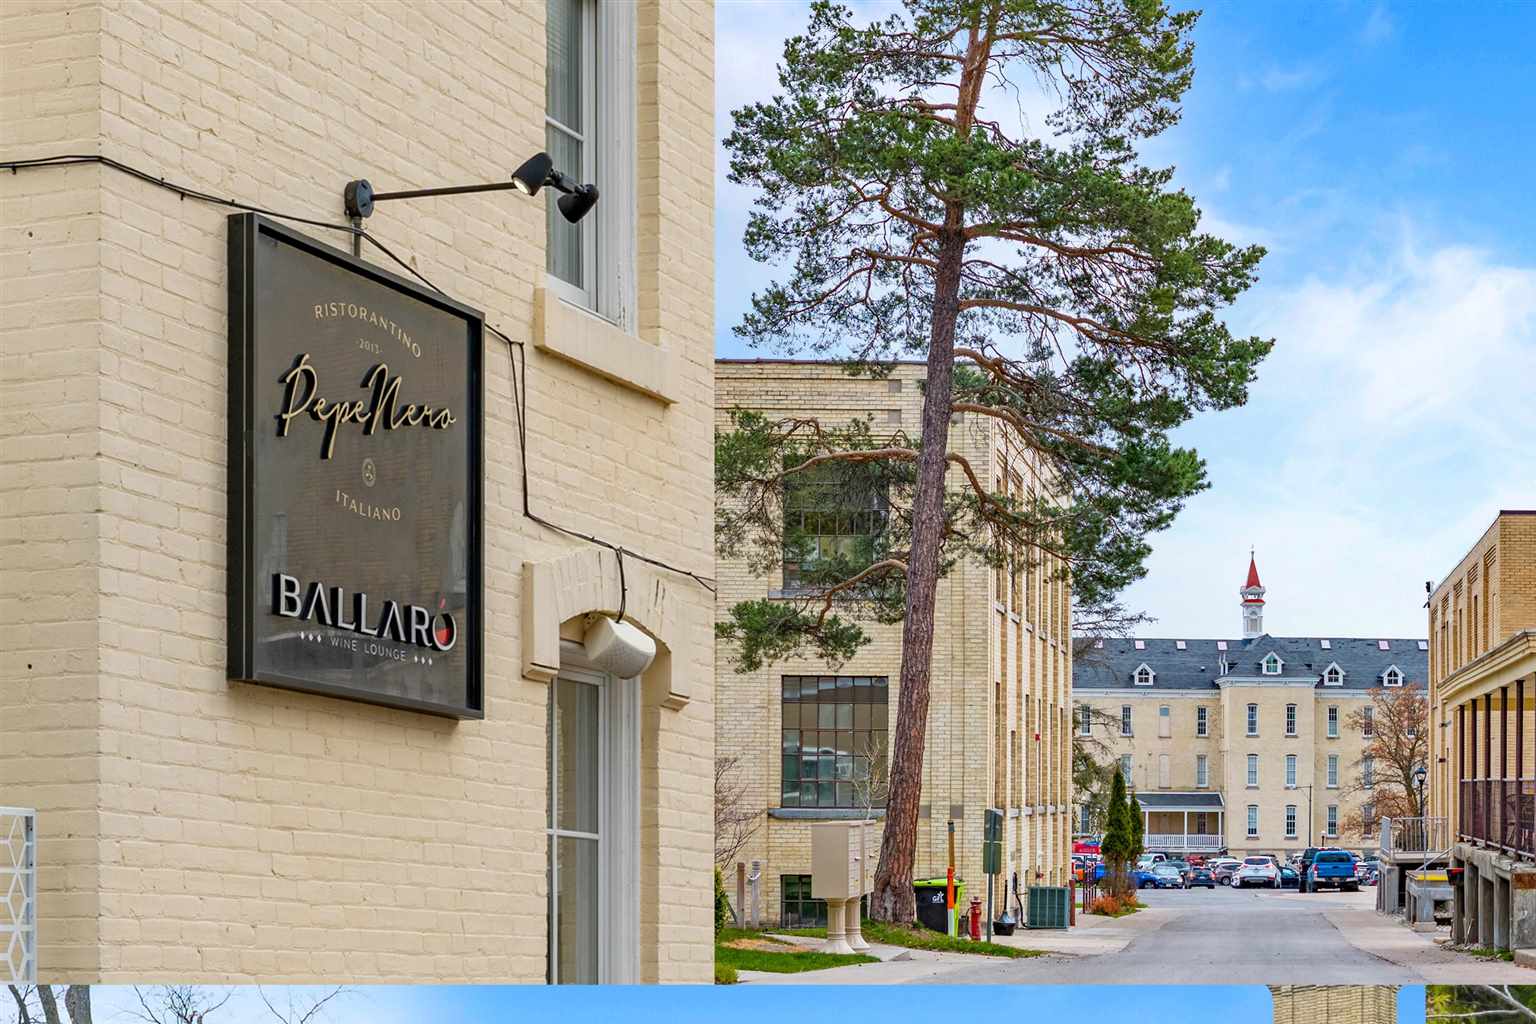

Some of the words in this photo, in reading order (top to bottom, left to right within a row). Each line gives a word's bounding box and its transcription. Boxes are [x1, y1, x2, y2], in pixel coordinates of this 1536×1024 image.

[314, 302, 421, 358] RISTORANTINO
[336, 490, 401, 521] ITALIANO
[331, 637, 358, 652] WINE
[364, 643, 407, 662] LOUNGE
